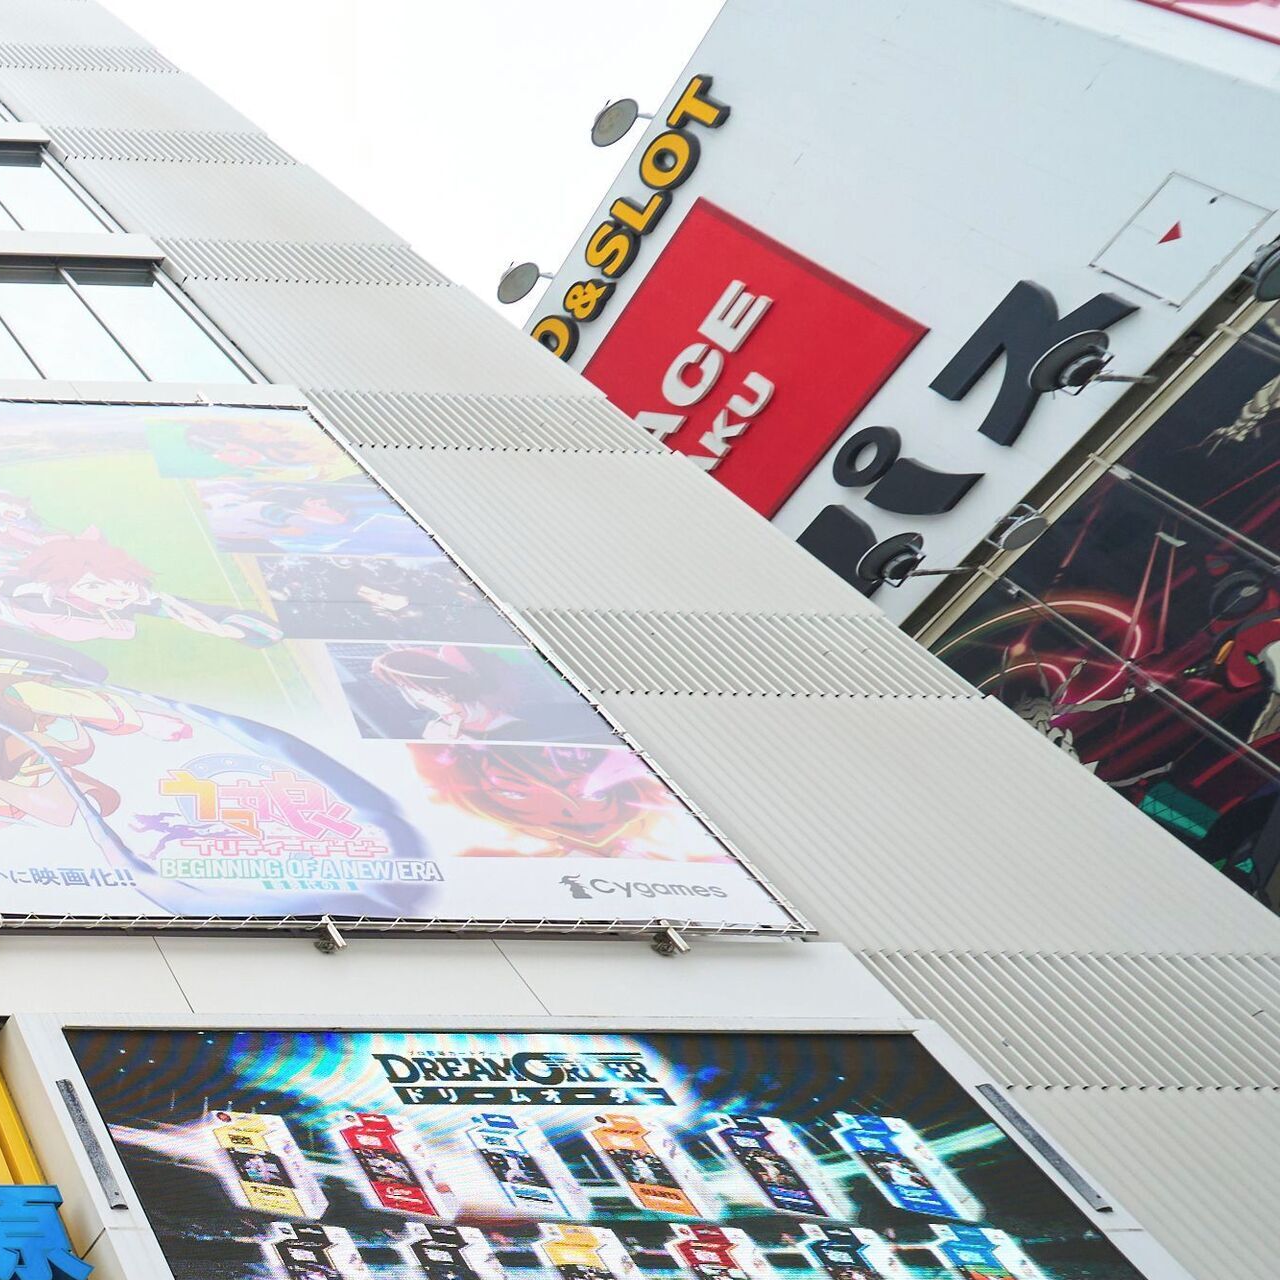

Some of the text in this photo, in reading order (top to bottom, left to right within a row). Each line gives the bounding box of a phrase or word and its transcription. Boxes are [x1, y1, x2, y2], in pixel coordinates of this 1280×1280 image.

[159, 858, 446, 882] BEGINNING OF A NEW ERA
[589, 878, 728, 899] Cygames
[405, 1088, 664, 1105] ドリームオーダー
